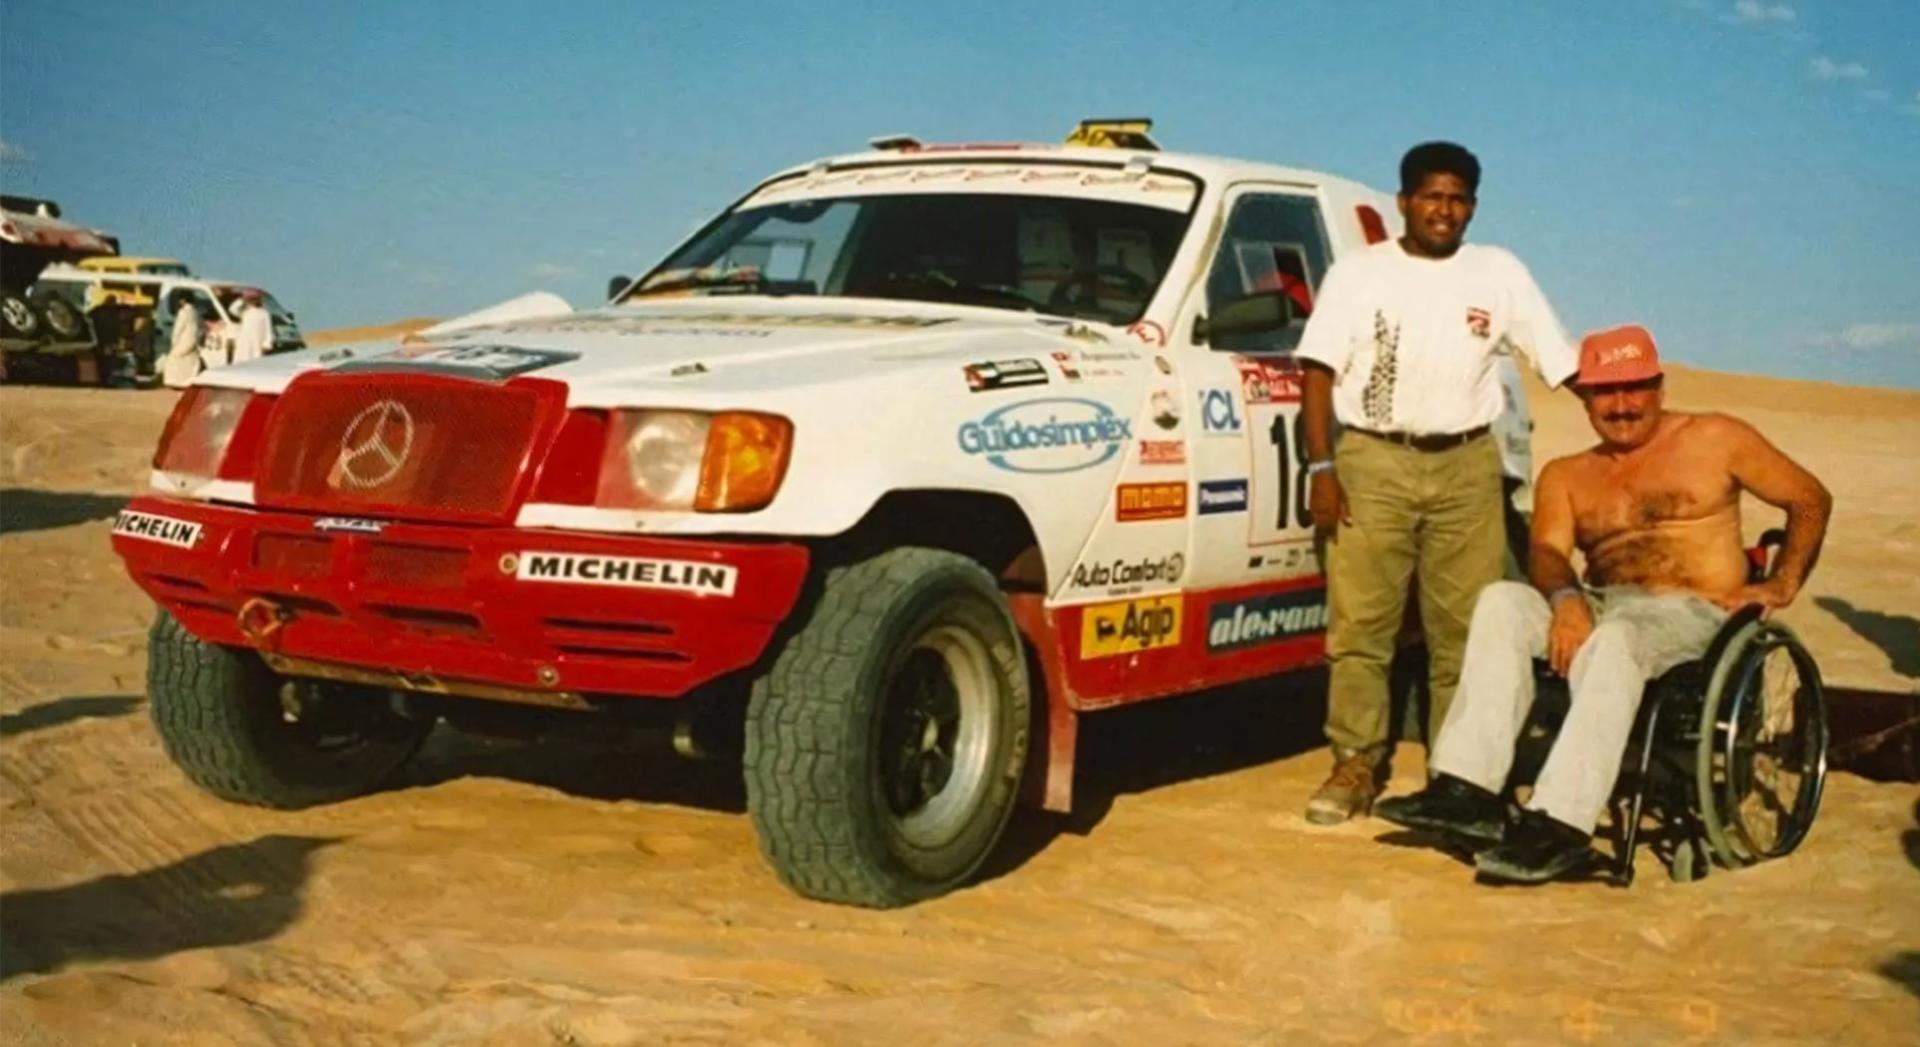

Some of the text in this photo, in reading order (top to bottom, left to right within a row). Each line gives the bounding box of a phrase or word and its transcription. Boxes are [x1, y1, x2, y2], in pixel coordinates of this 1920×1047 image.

[958, 413, 1133, 455] Guidosimplex
[528, 556, 726, 590] MICHELIN
[1070, 556, 1168, 588] Auto Comfort
[1120, 596, 1175, 649] Agip
